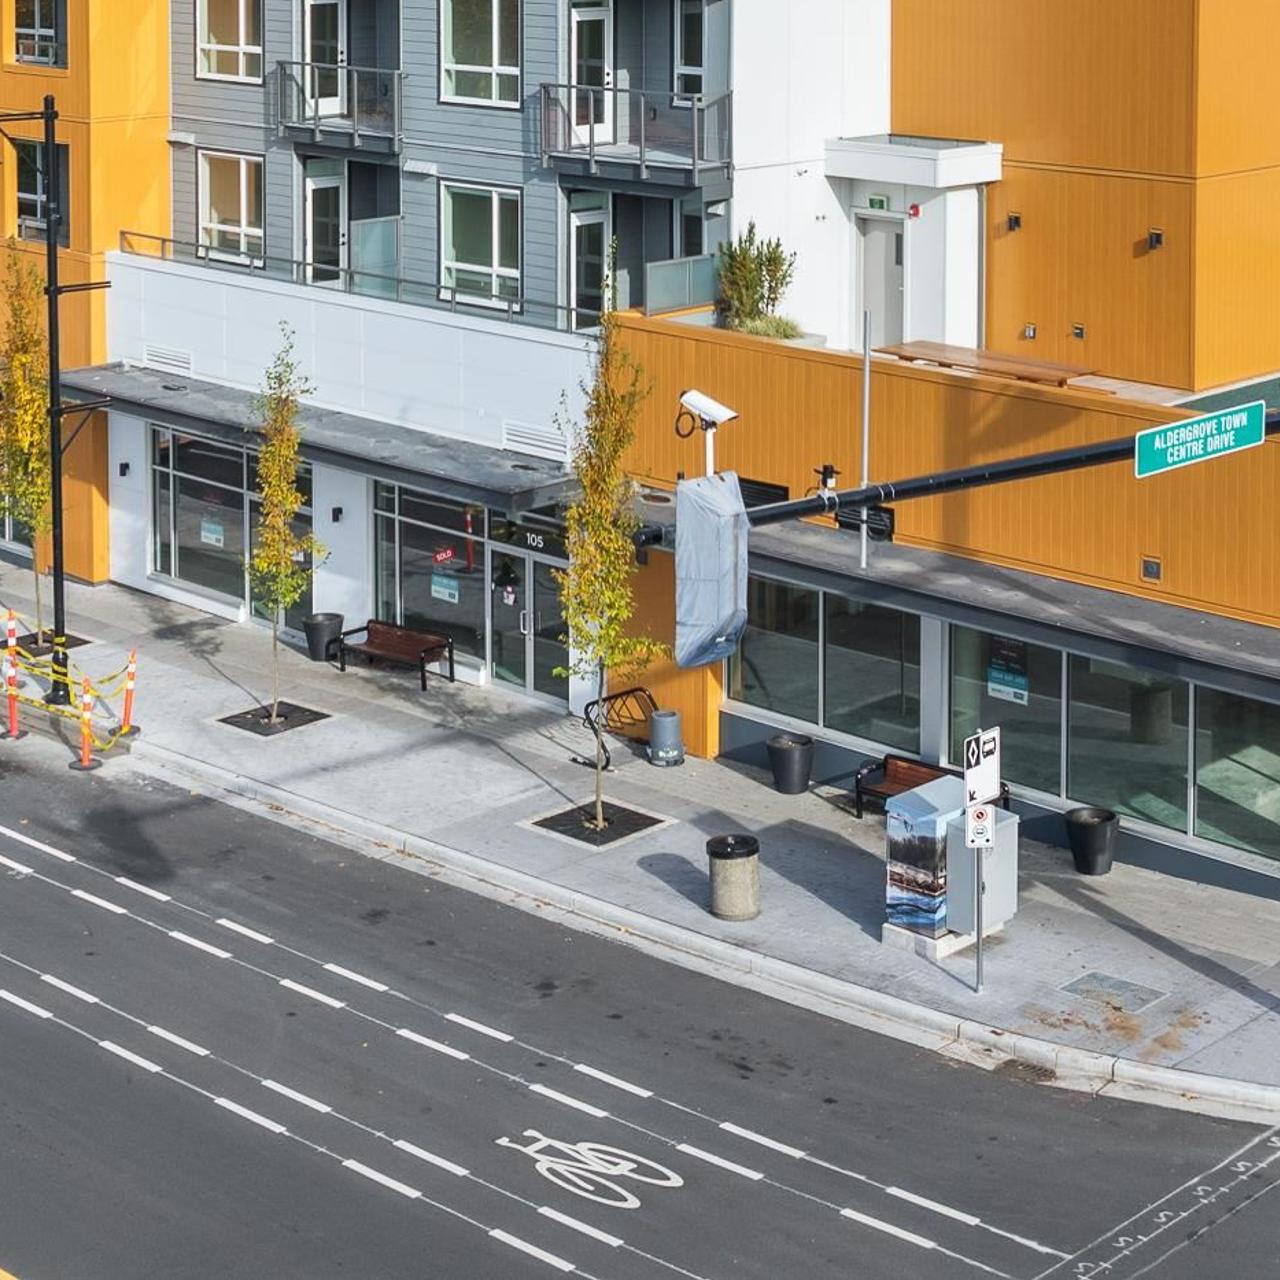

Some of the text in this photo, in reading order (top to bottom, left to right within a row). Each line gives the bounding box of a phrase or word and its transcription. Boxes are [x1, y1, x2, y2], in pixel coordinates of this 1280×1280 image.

[1154, 411, 1248, 450] ALDERGROVE TOWN
[1167, 430, 1235, 463] CENTRE DRIVE
[526, 532, 544, 548] 105
[436, 549, 452, 562] SOLD
